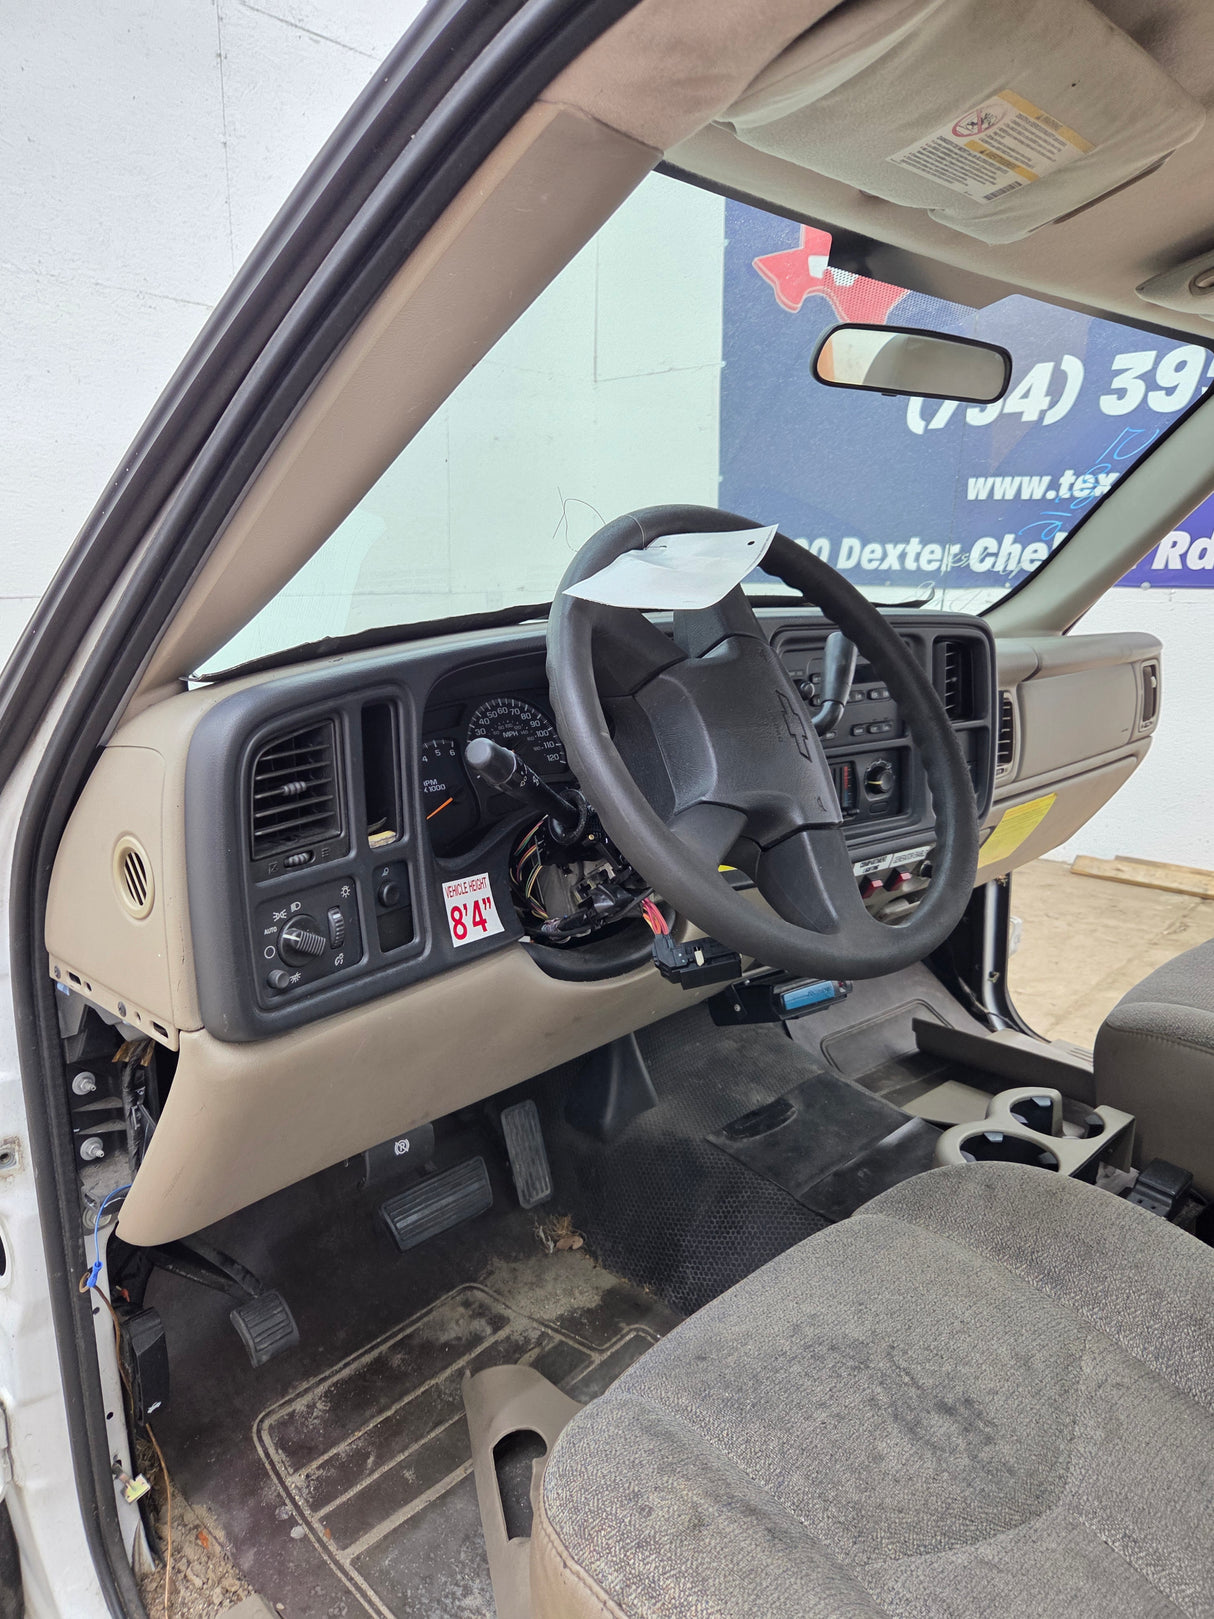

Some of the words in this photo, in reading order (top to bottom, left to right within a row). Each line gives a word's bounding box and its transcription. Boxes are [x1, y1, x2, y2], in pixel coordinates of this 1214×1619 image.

[836, 536, 960, 571] Dexter
[969, 531, 1069, 572] Che
[486, 710, 498, 719] 50
[497, 706, 508, 715] 60
[510, 707, 520, 716] 70
[520, 712, 531, 720] 80
[478, 717, 490, 725] 40
[530, 719, 541, 728] 90
[475, 727, 486, 736] 30
[502, 730, 519, 738] MPH
[536, 729, 549, 738] 100
[543, 741, 555, 749] 110
[435, 749, 441, 757] 5
[449, 749, 456, 757] 6
[547, 753, 560, 762] 120
[445, 881, 469, 898] VEHICLE
[468, 877, 487, 892] HEIGHT
[264, 926, 278, 935] AUTO
